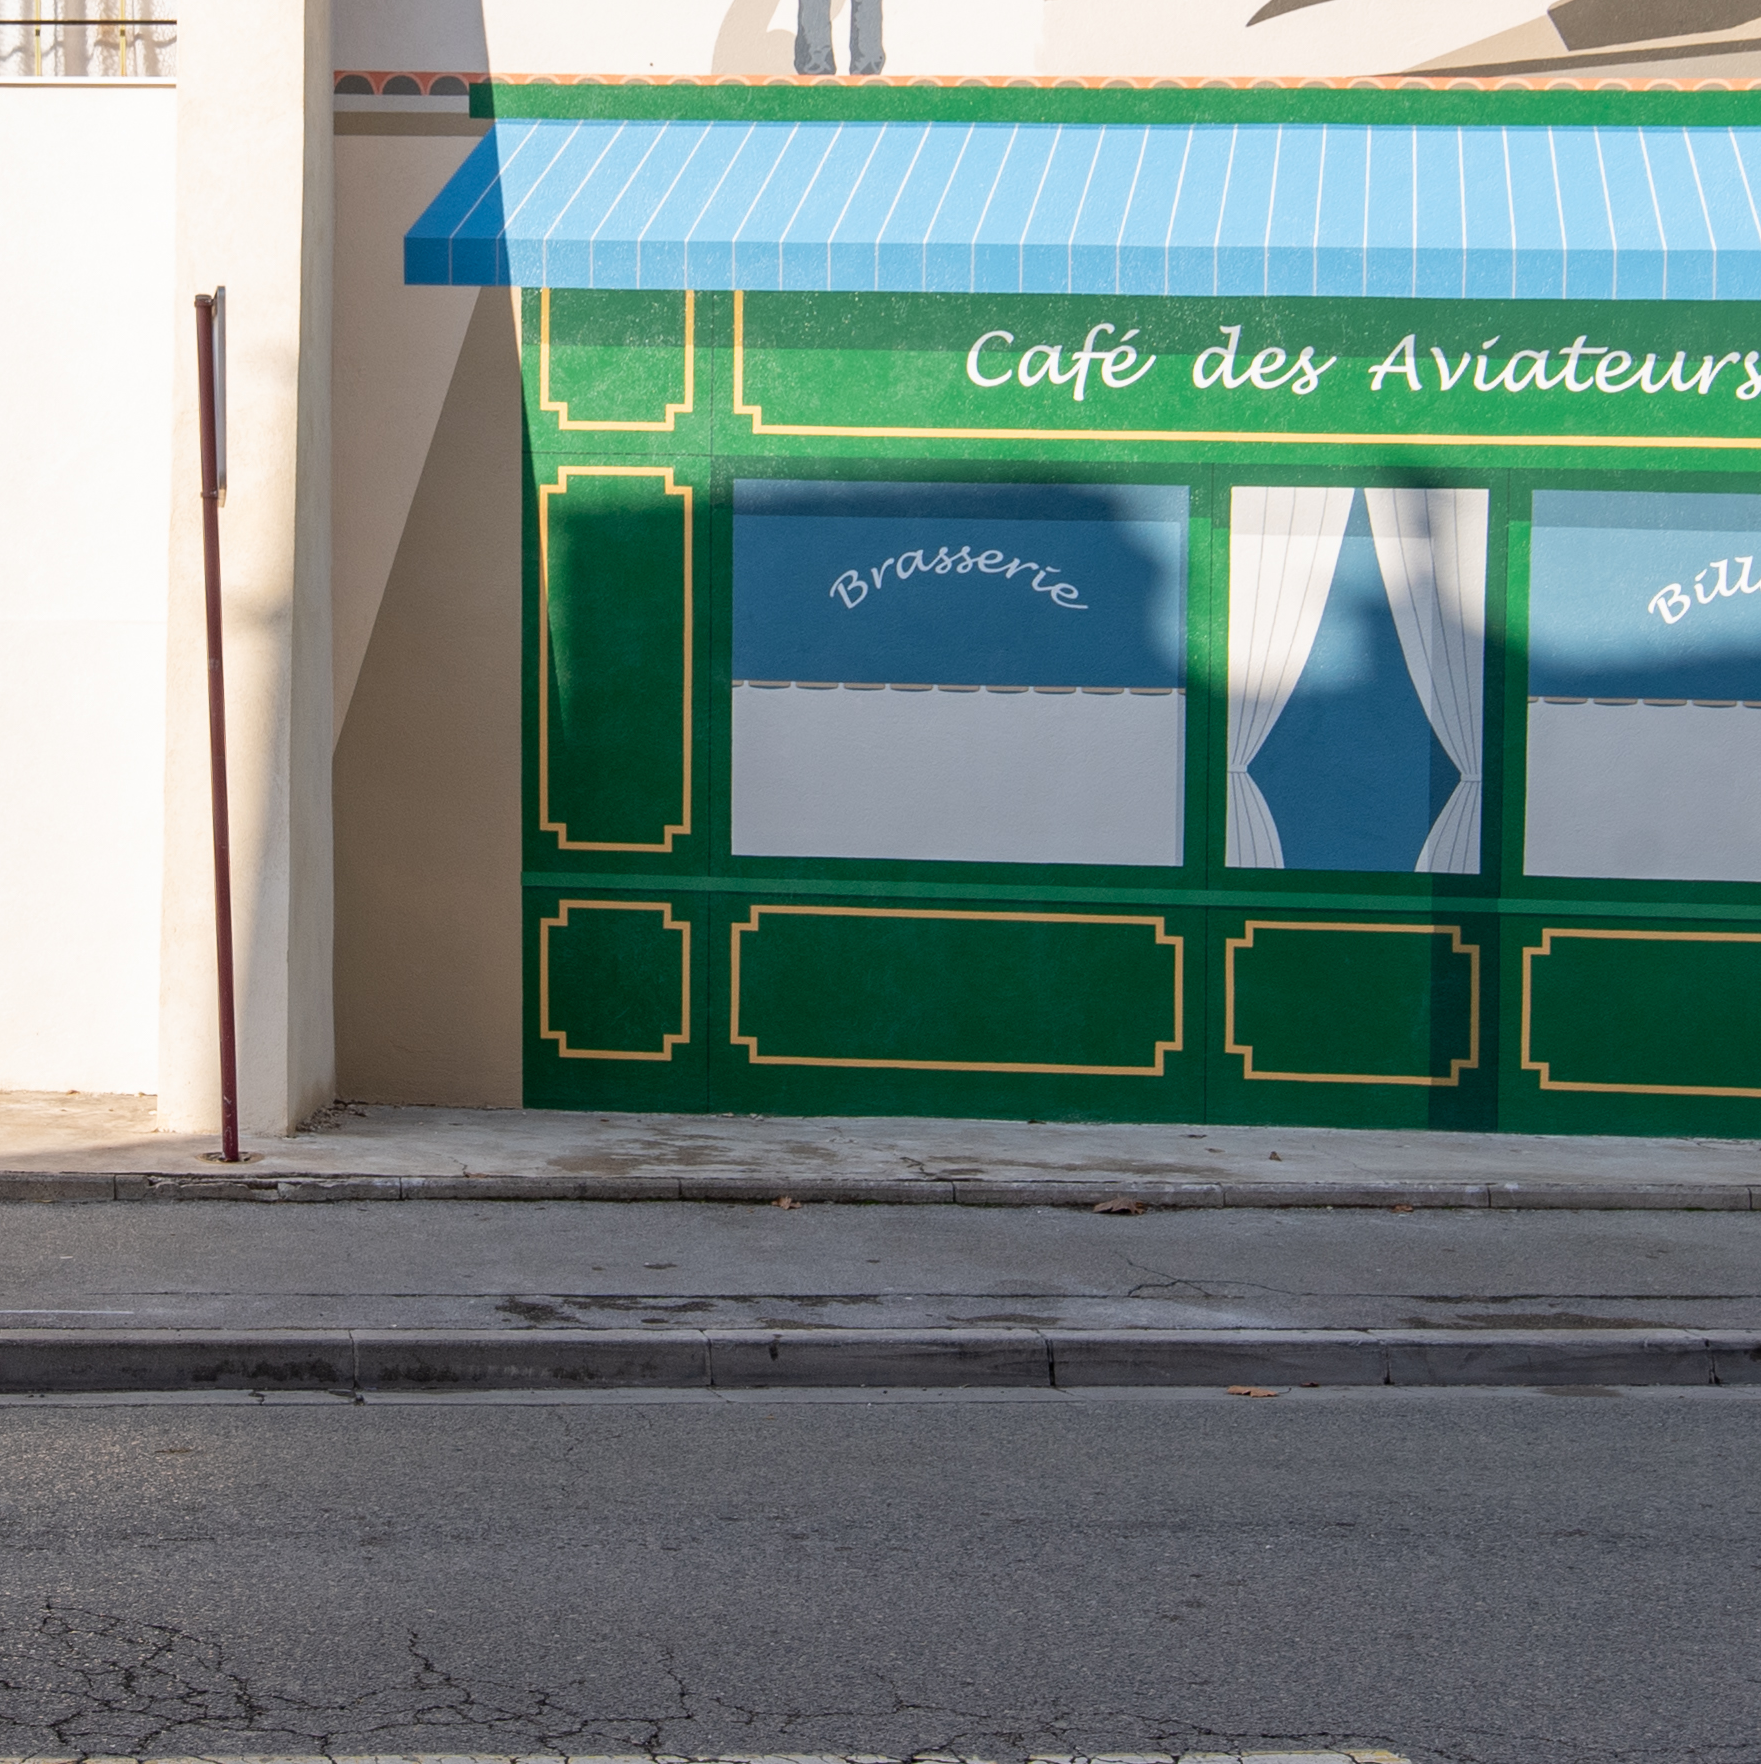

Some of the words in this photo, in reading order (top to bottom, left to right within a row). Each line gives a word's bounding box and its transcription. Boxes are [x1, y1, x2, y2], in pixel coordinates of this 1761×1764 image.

[966, 322, 1156, 402] Café
[1192, 324, 1337, 395] des
[829, 545, 1088, 609] Brasserie
